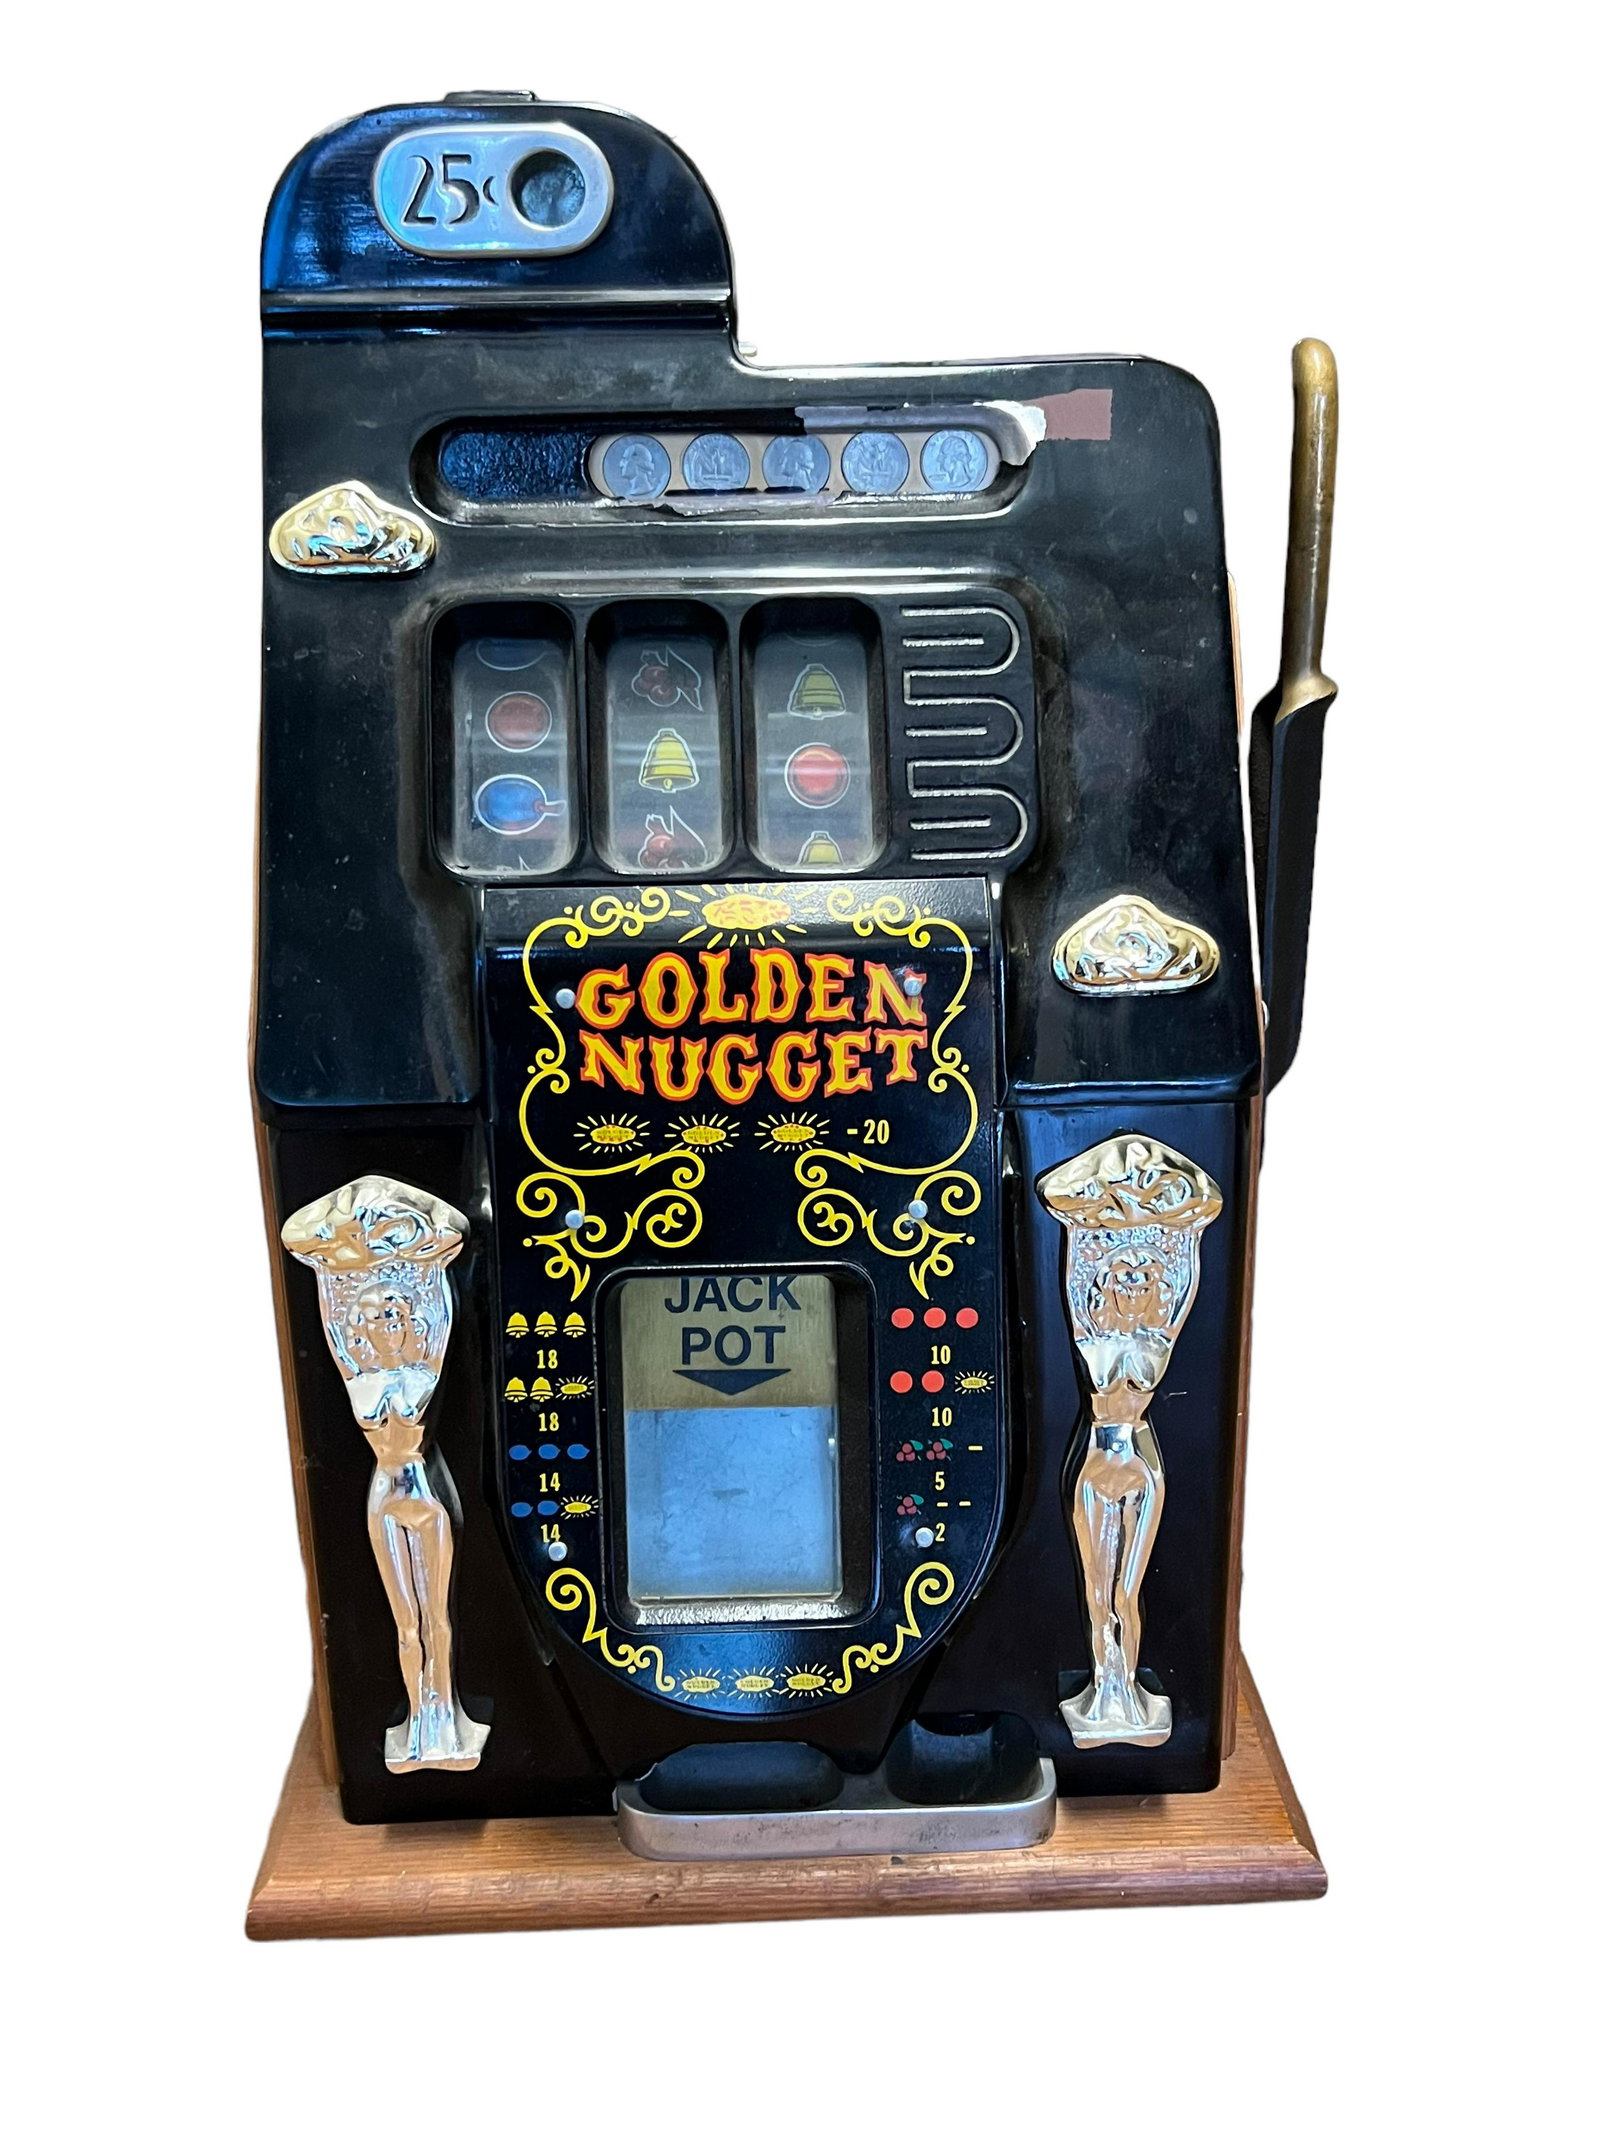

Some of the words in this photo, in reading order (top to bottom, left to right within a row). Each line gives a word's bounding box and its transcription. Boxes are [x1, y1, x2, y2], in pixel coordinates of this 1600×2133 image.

[575, 947, 927, 1029] GOLDEN
[579, 1027, 928, 1105] NUGGET
[664, 1276, 802, 1314] JACK
[681, 1324, 787, 1366] POT
[930, 1345, 952, 1365] 10
[536, 1349, 559, 1369] 18
[538, 1412, 560, 1432] 18
[931, 1407, 953, 1427] 10
[539, 1472, 561, 1493] 14
[934, 1471, 946, 1491] 5
[540, 1523, 562, 1543] 14
[934, 1522, 946, 1542] 2
